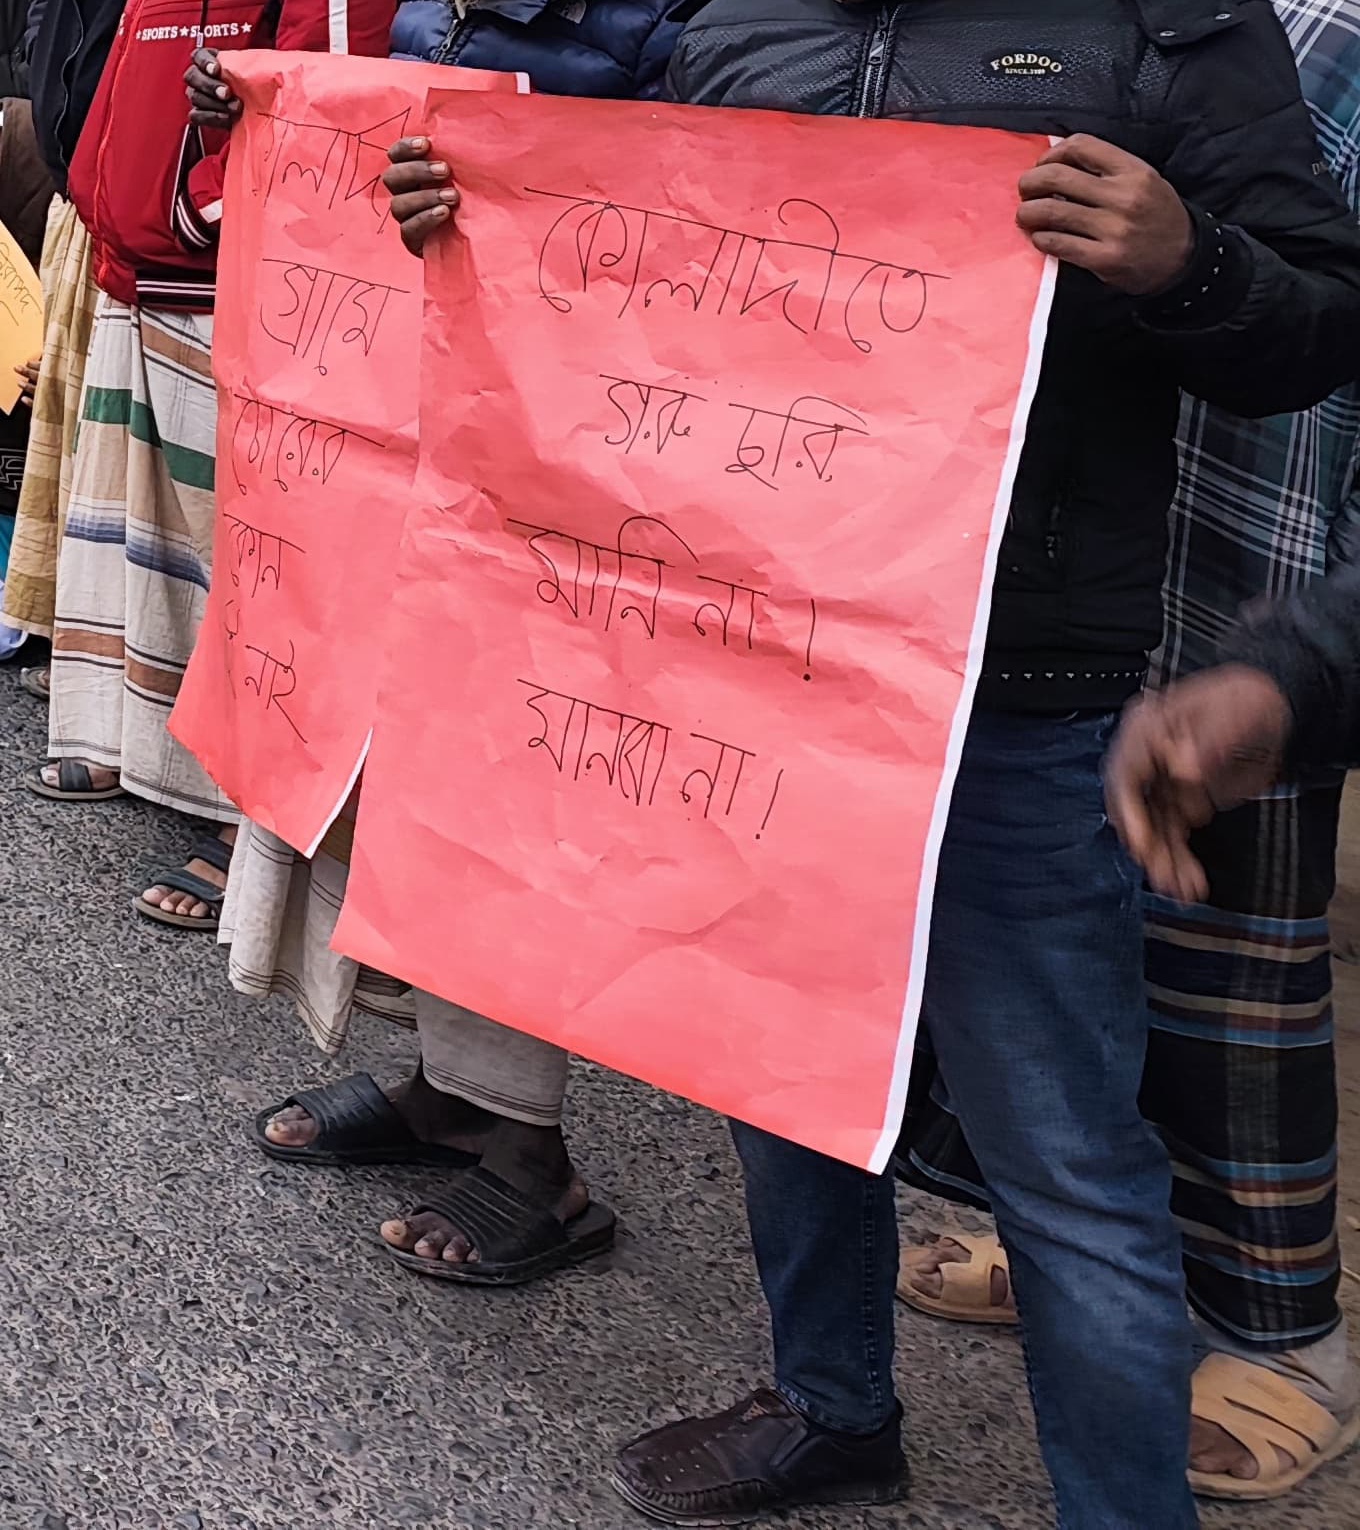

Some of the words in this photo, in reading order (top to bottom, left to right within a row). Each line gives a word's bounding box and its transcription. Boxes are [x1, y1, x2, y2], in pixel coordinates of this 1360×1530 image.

[190, 23, 239, 38] SORTS
[990, 53, 1062, 73] FORDOO
[598, 373, 708, 455] গরু
[724, 395, 871, 492] চুরি
[506, 515, 701, 640] মানি
